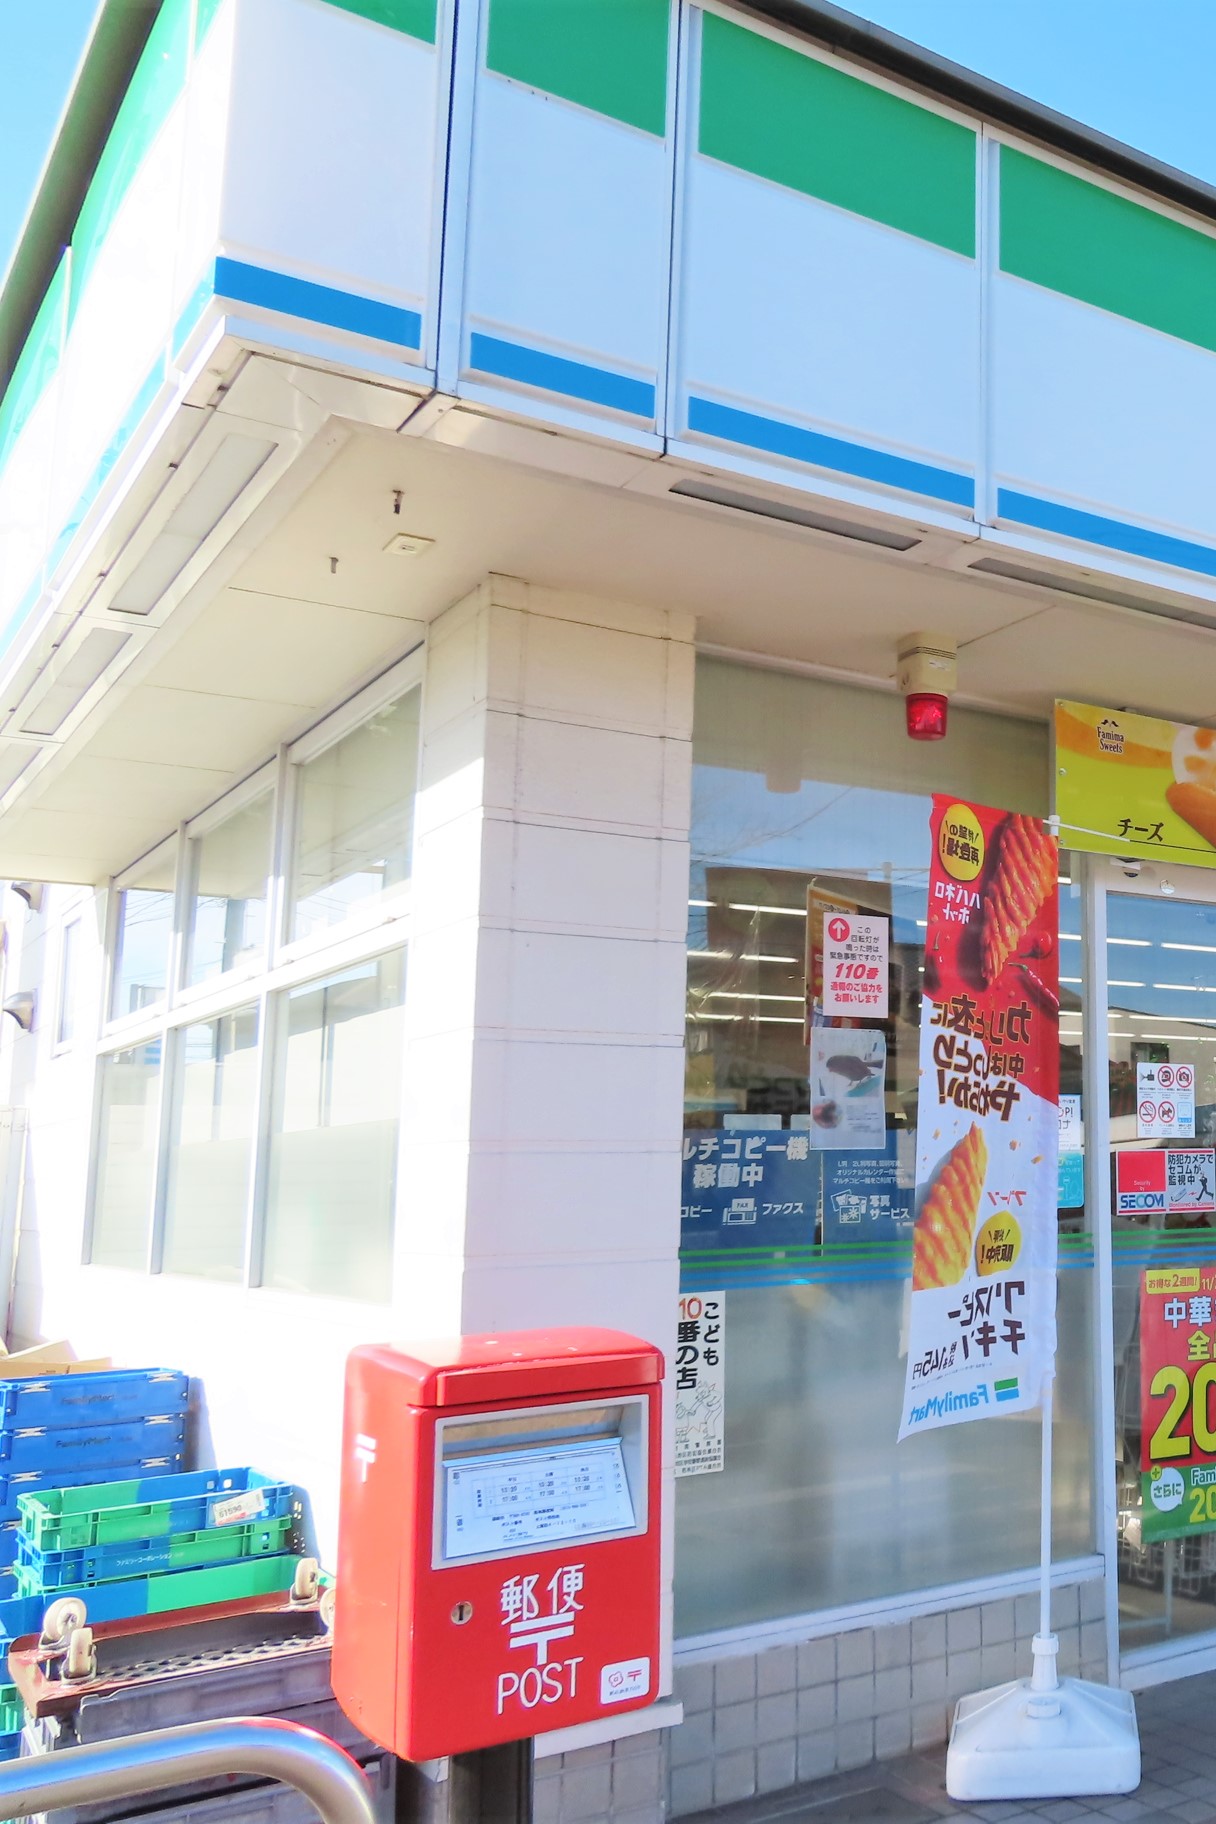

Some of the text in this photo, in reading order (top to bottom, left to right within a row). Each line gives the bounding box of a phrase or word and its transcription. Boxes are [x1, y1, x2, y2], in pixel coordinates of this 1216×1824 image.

[1097, 726, 1125, 743] Famima
[1100, 738, 1123, 754] Sweets
[1117, 818, 1164, 842] チーズ
[857, 926, 872, 934] この
[835, 963, 880, 979] 110番
[830, 981, 883, 993] 通報のご協力を
[834, 993, 880, 1004] お願いします
[1168, 1154, 1214, 1165] 防犯カメラで
[692, 1162, 764, 1188] 稼働中
[1168, 1164, 1202, 1175] セコムが
[1168, 1174, 1196, 1186] 監視中
[869, 1195, 891, 1207] 写真
[1120, 1194, 1165, 1209] SECOM
[762, 1202, 804, 1216] ファクス
[869, 1207, 911, 1220] サービス
[1148, 1273, 1198, 1289] お得な2週間!
[703, 1301, 721, 1366] こども
[1152, 1482, 1183, 1498] さらに
[500, 1562, 585, 1626] 郵便
[496, 1656, 586, 1716] POST
